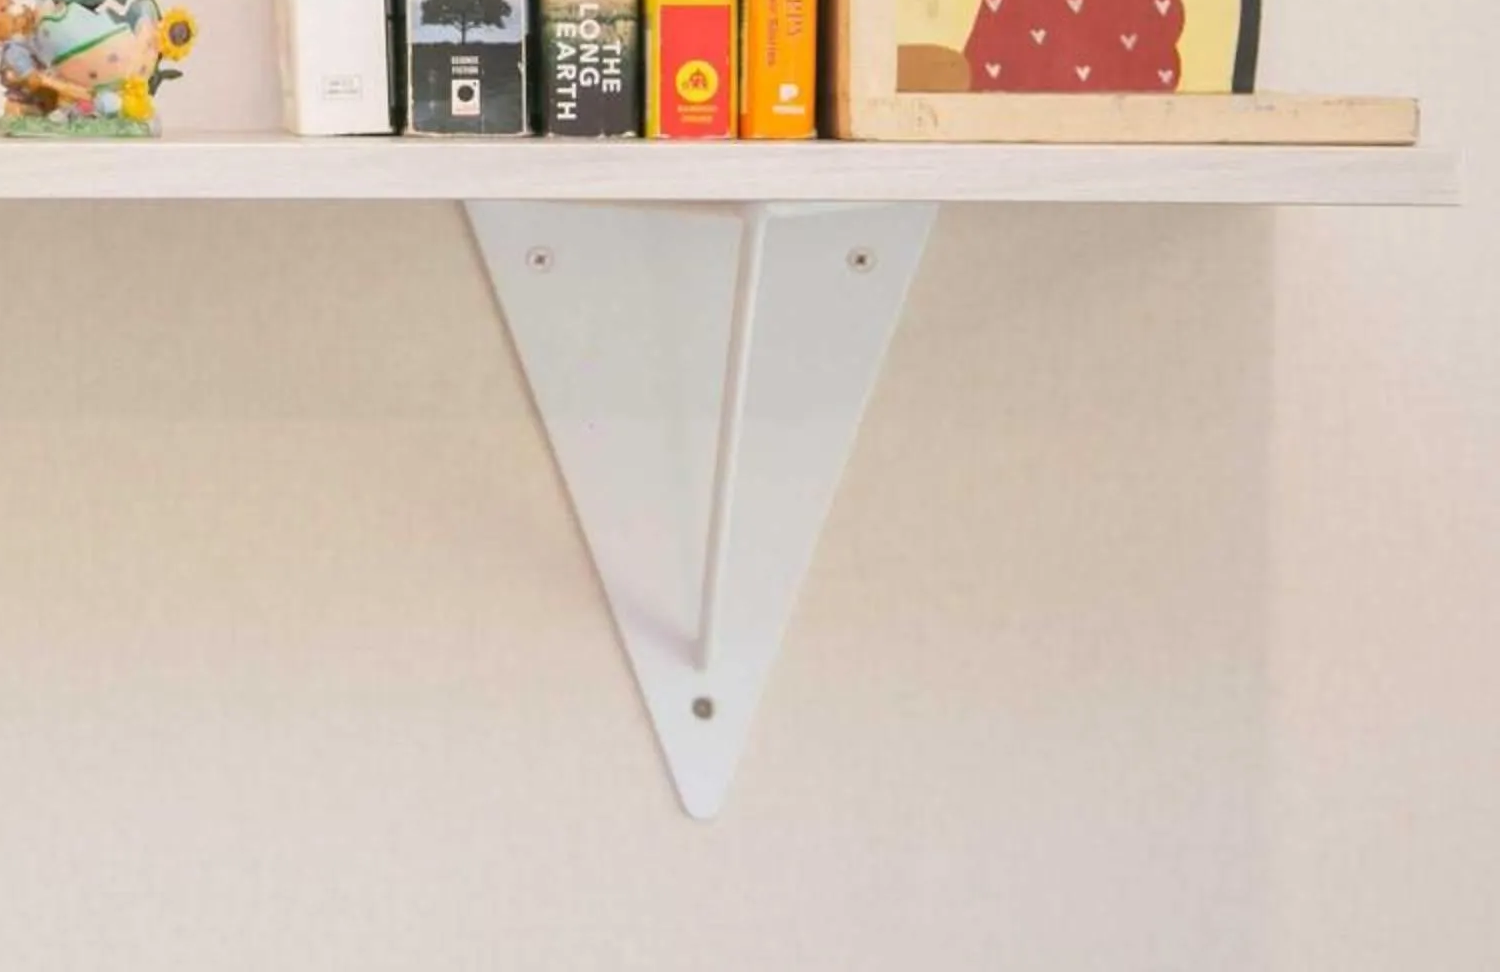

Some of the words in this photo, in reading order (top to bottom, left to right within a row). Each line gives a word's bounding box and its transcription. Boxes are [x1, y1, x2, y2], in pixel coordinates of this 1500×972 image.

[556, 22, 577, 120] EARTH
[579, 3, 601, 87] LONG
[602, 40, 621, 93] THE
